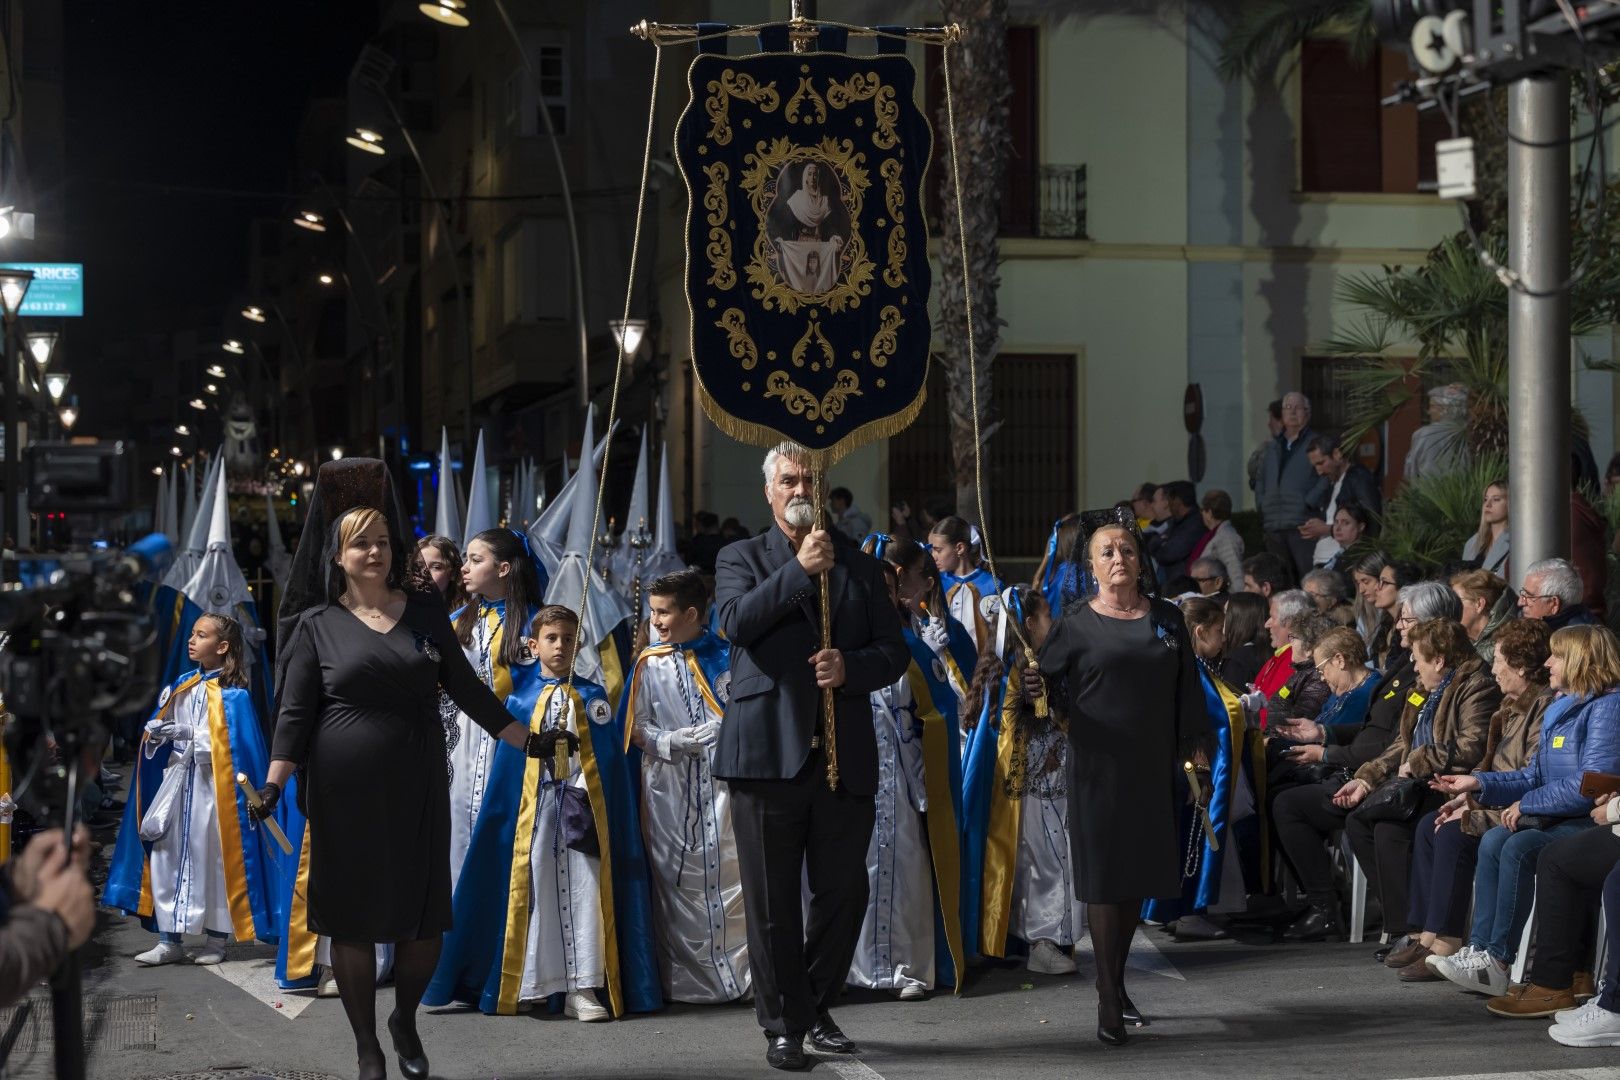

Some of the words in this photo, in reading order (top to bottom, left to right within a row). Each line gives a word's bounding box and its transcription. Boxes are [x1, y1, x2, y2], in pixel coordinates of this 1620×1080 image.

[32, 267, 79, 280] ARICES
[30, 302, 41, 311] 63
[43, 302, 54, 311] 17
